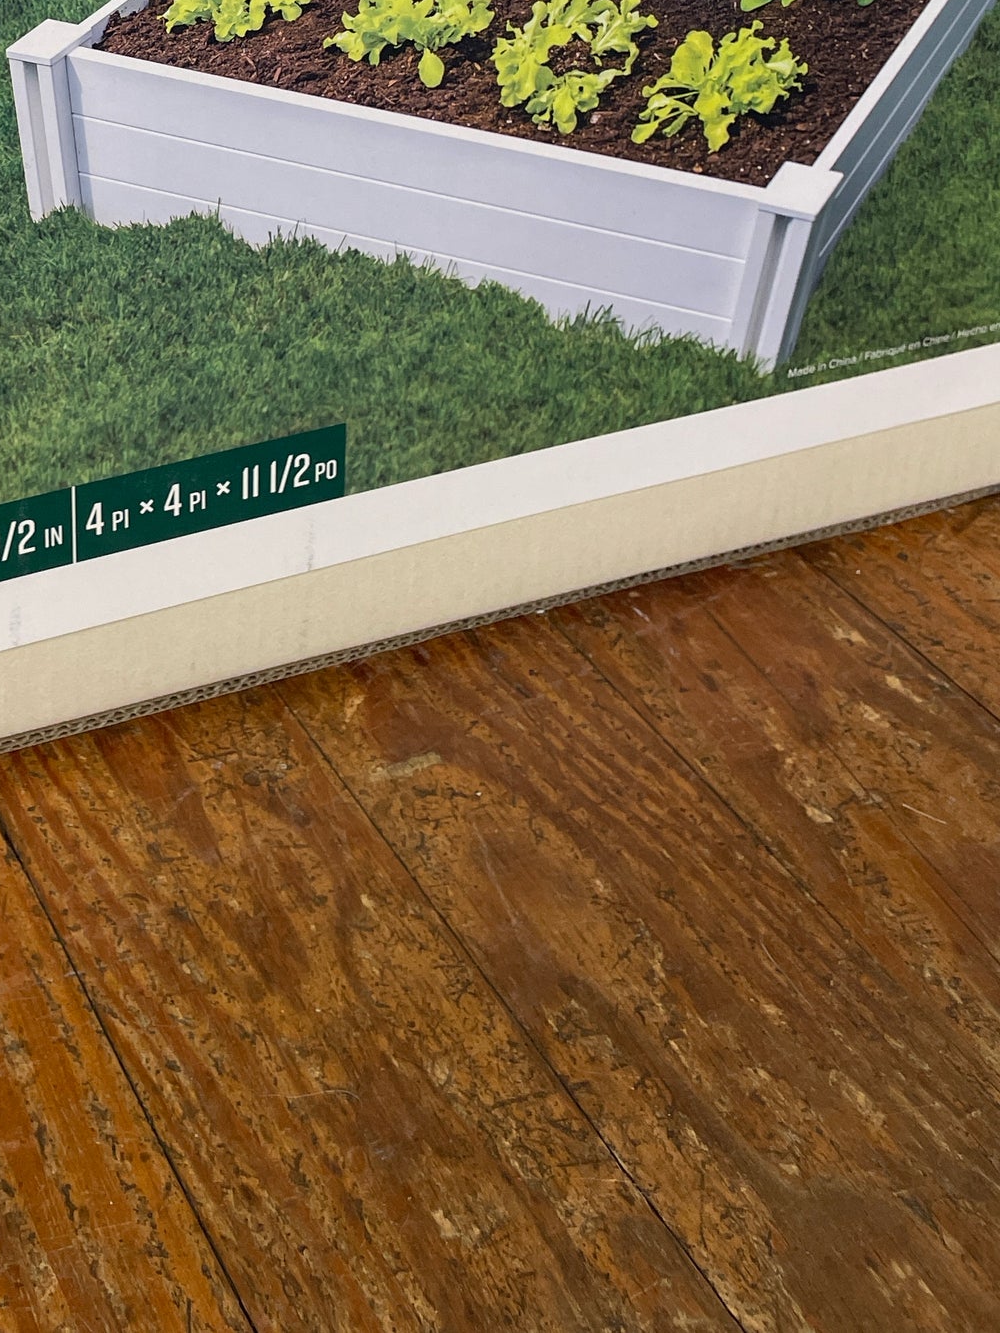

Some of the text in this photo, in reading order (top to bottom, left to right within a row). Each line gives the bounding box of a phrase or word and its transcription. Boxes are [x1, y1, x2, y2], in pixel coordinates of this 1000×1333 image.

[787, 364, 816, 378] Made
[86, 503, 104, 535] 4
[164, 484, 182, 516] 4
[243, 465, 258, 499] 11
[271, 454, 310, 493] 1/2
